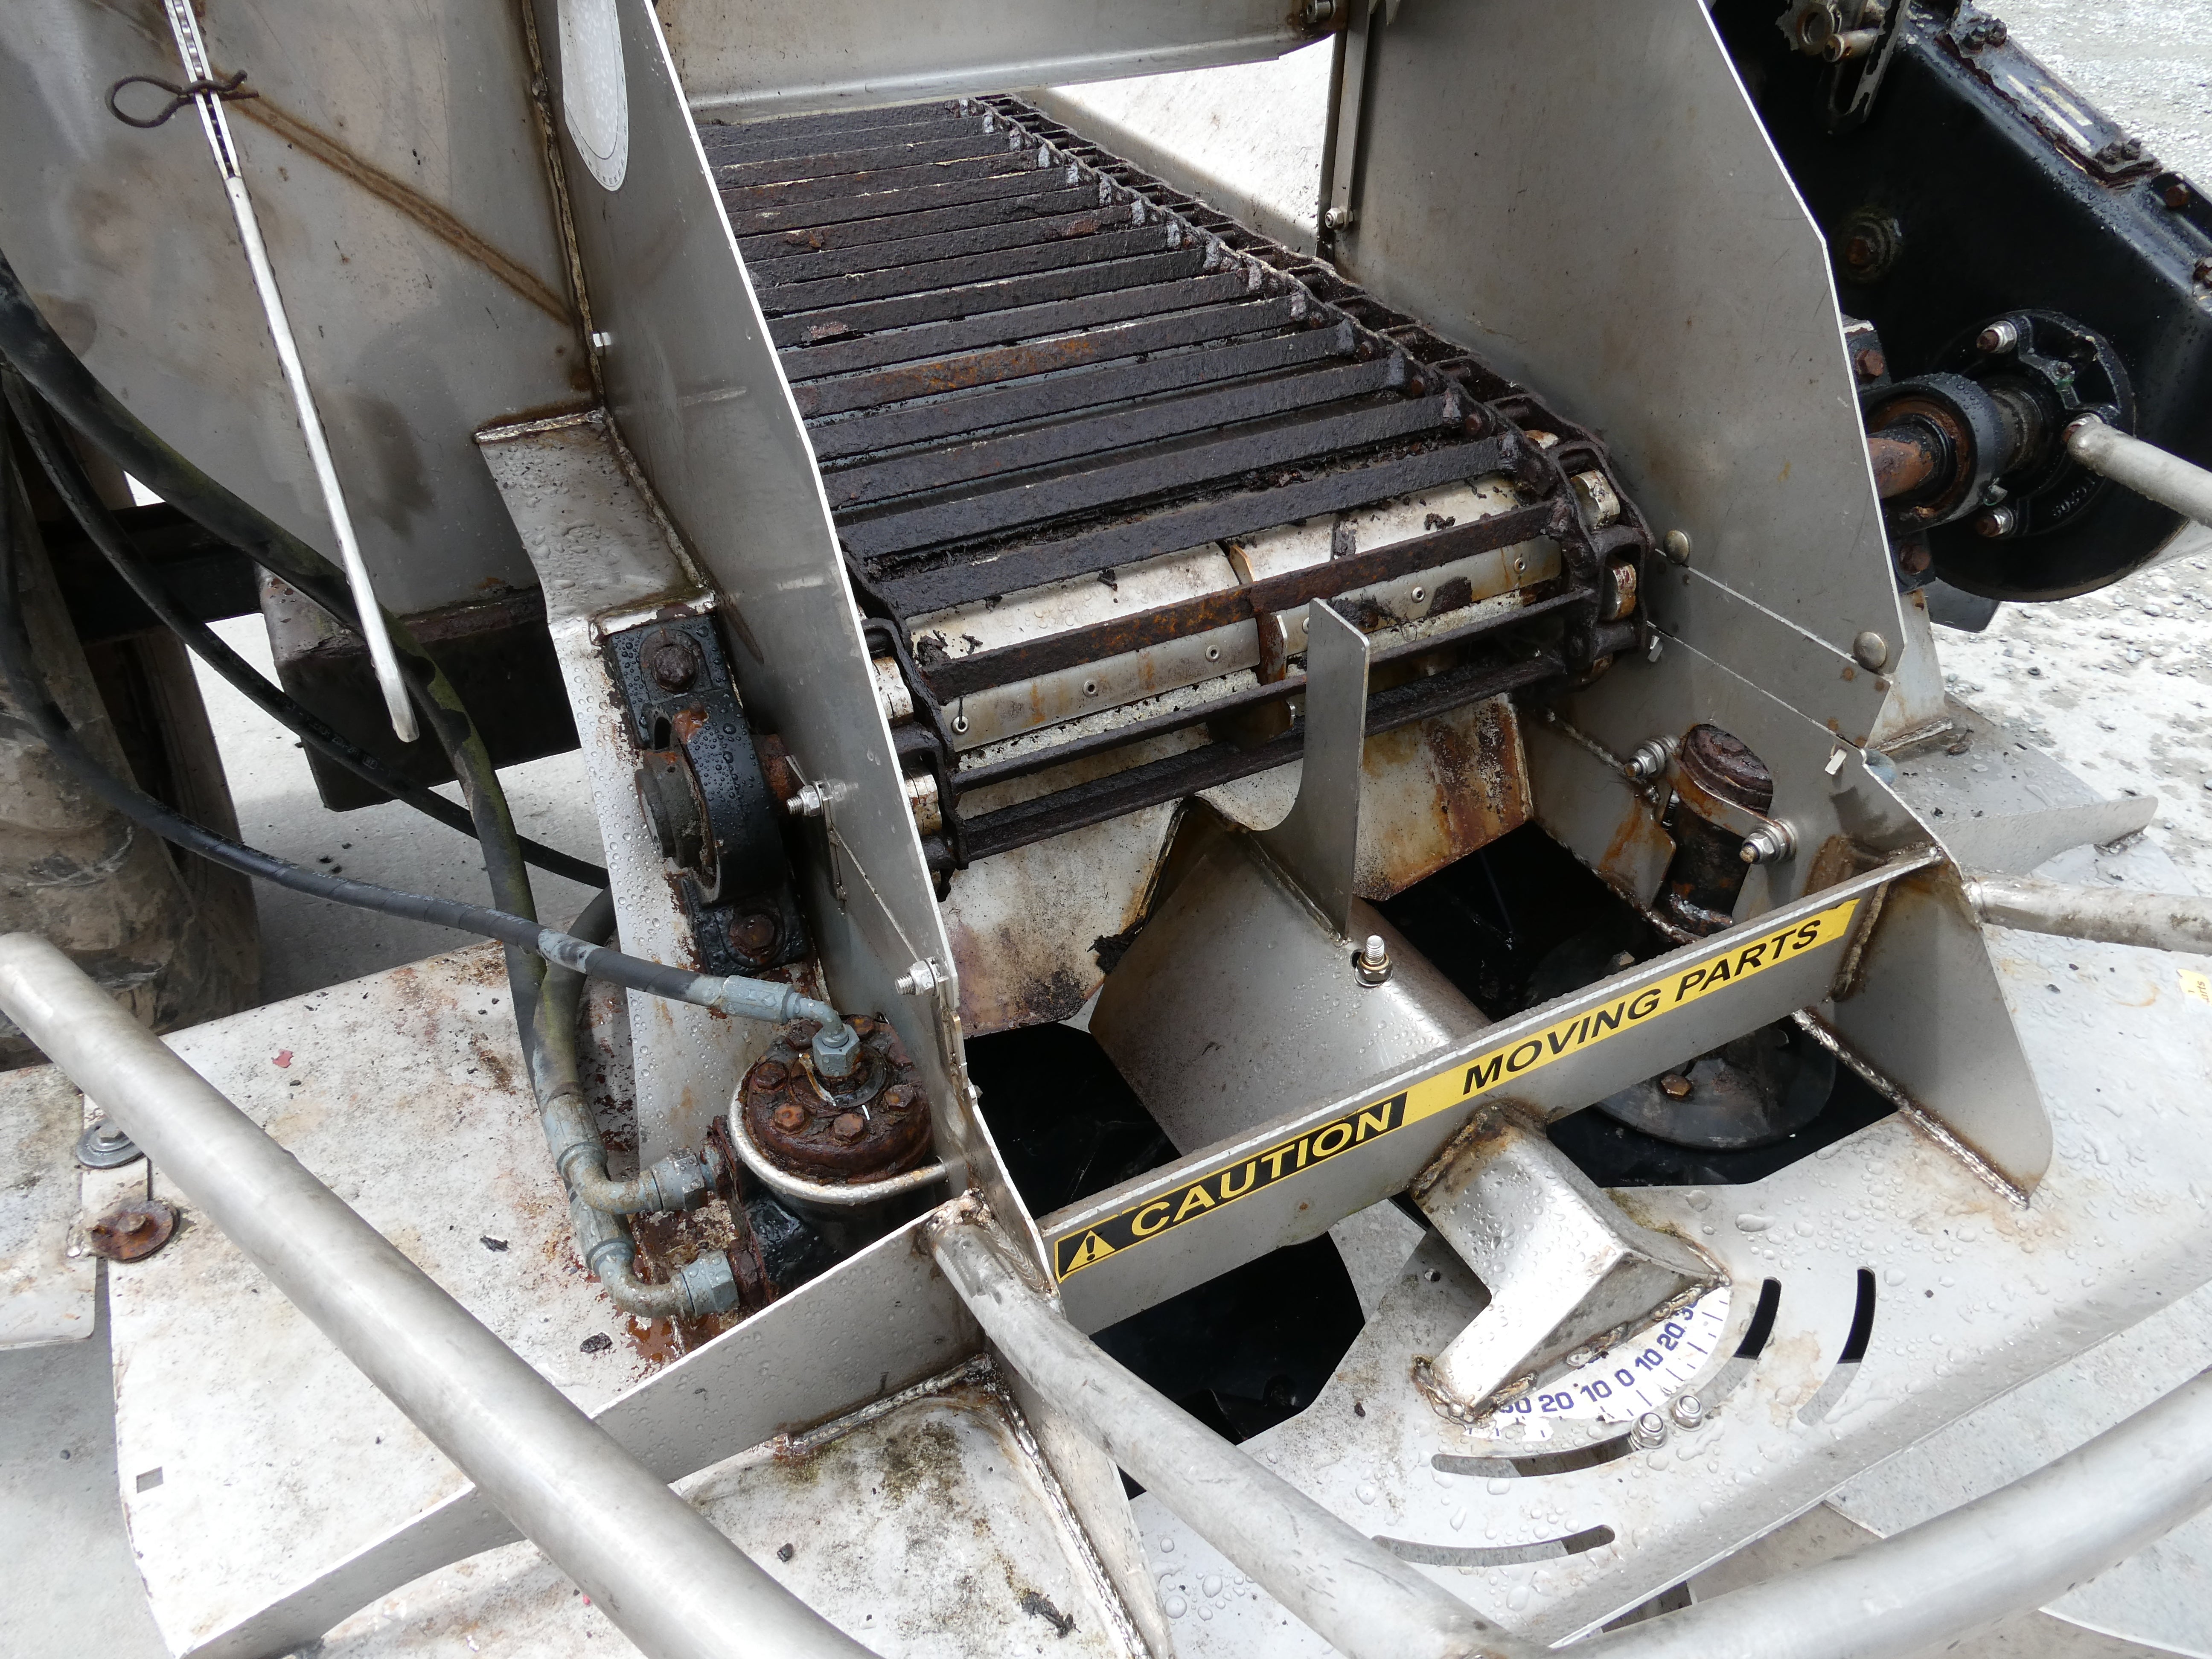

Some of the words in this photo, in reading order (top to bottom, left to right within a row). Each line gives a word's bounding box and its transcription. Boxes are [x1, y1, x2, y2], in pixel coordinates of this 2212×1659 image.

[1131, 1102, 1393, 1237] CAUTION
[1462, 988, 1661, 1095] MOVING
[1675, 920, 1821, 1001] PARTS
[1538, 1392, 1575, 1412] 20
[1580, 1380, 1612, 1402] 10
[1614, 1368, 1635, 1387] 0
[1635, 1348, 1663, 1371] 10
[1657, 1322, 1685, 1351] 20
[1676, 1300, 1698, 1321] 3
